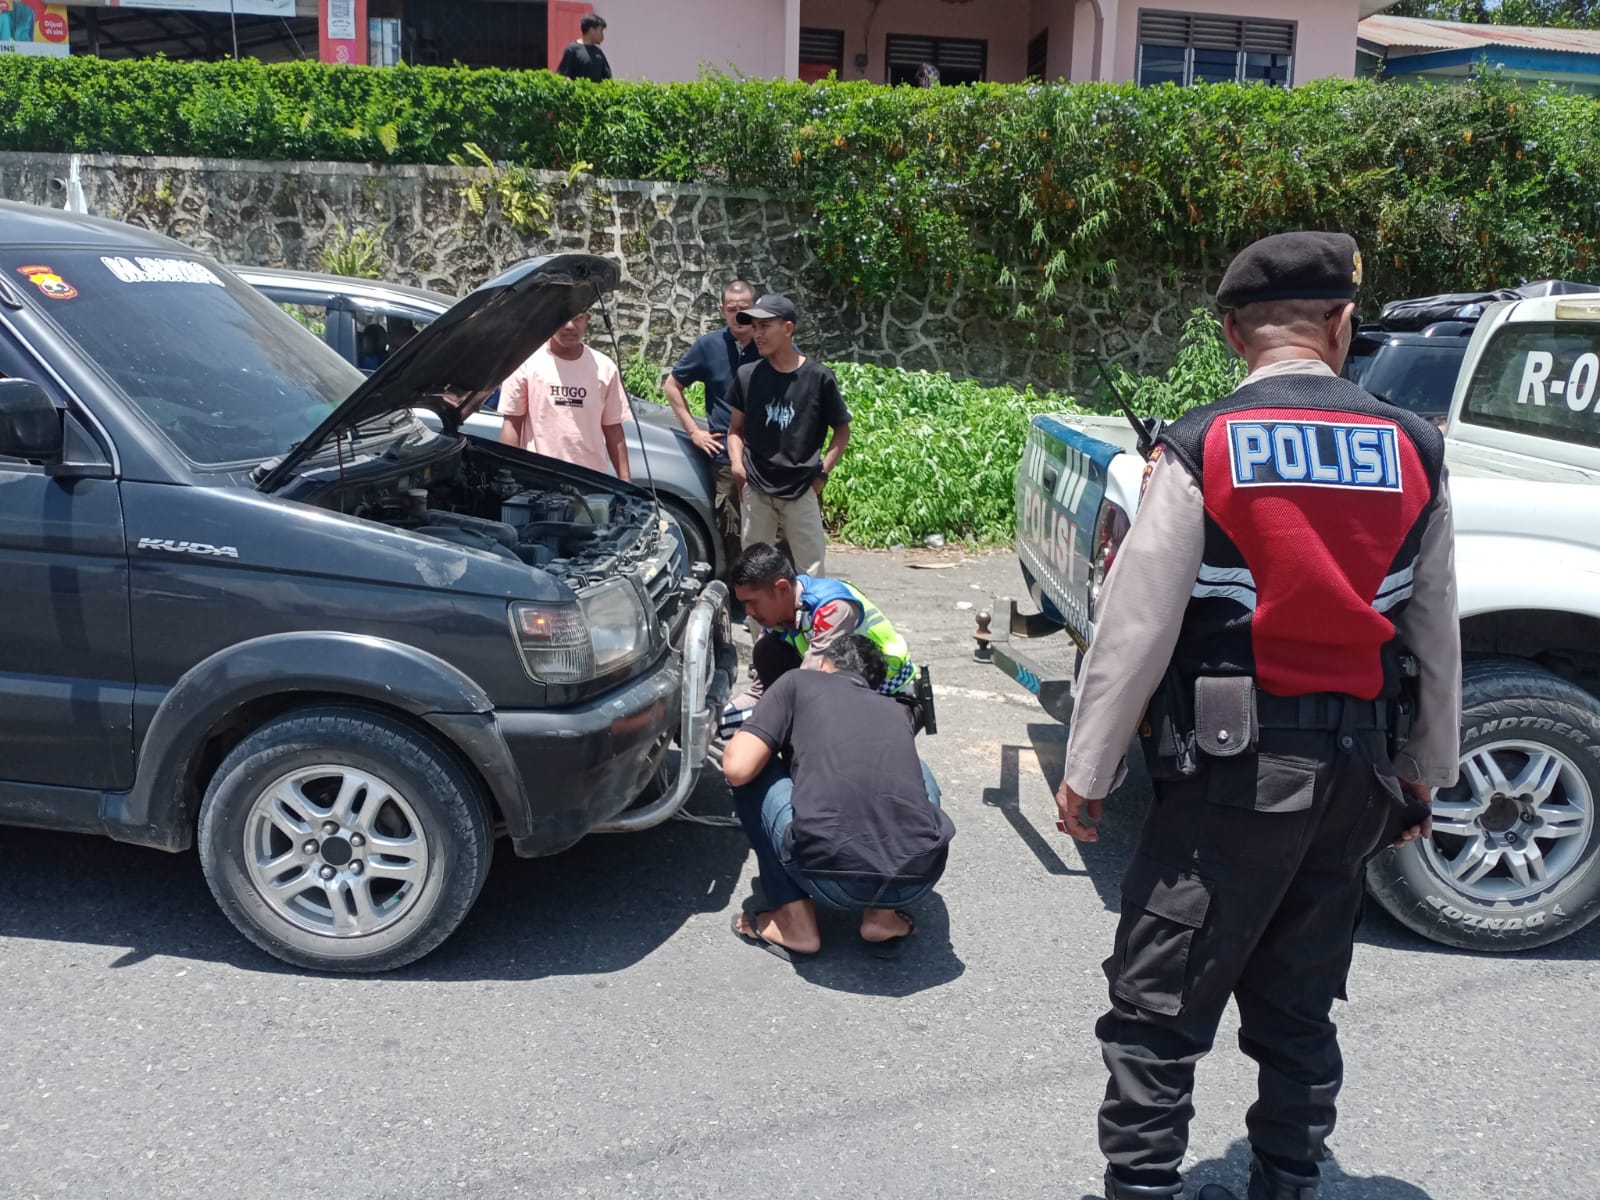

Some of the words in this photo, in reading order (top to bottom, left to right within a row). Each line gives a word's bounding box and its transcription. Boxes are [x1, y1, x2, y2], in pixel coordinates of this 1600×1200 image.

[550, 385, 587, 398] HUGO
[1517, 350, 1600, 414] R-0
[1232, 424, 1398, 486] POLISI
[137, 537, 239, 558] KUDA
[1024, 485, 1077, 585] POLISI
[1460, 716, 1591, 744] ANDTREK
[1425, 895, 1546, 931] DUNLOP
